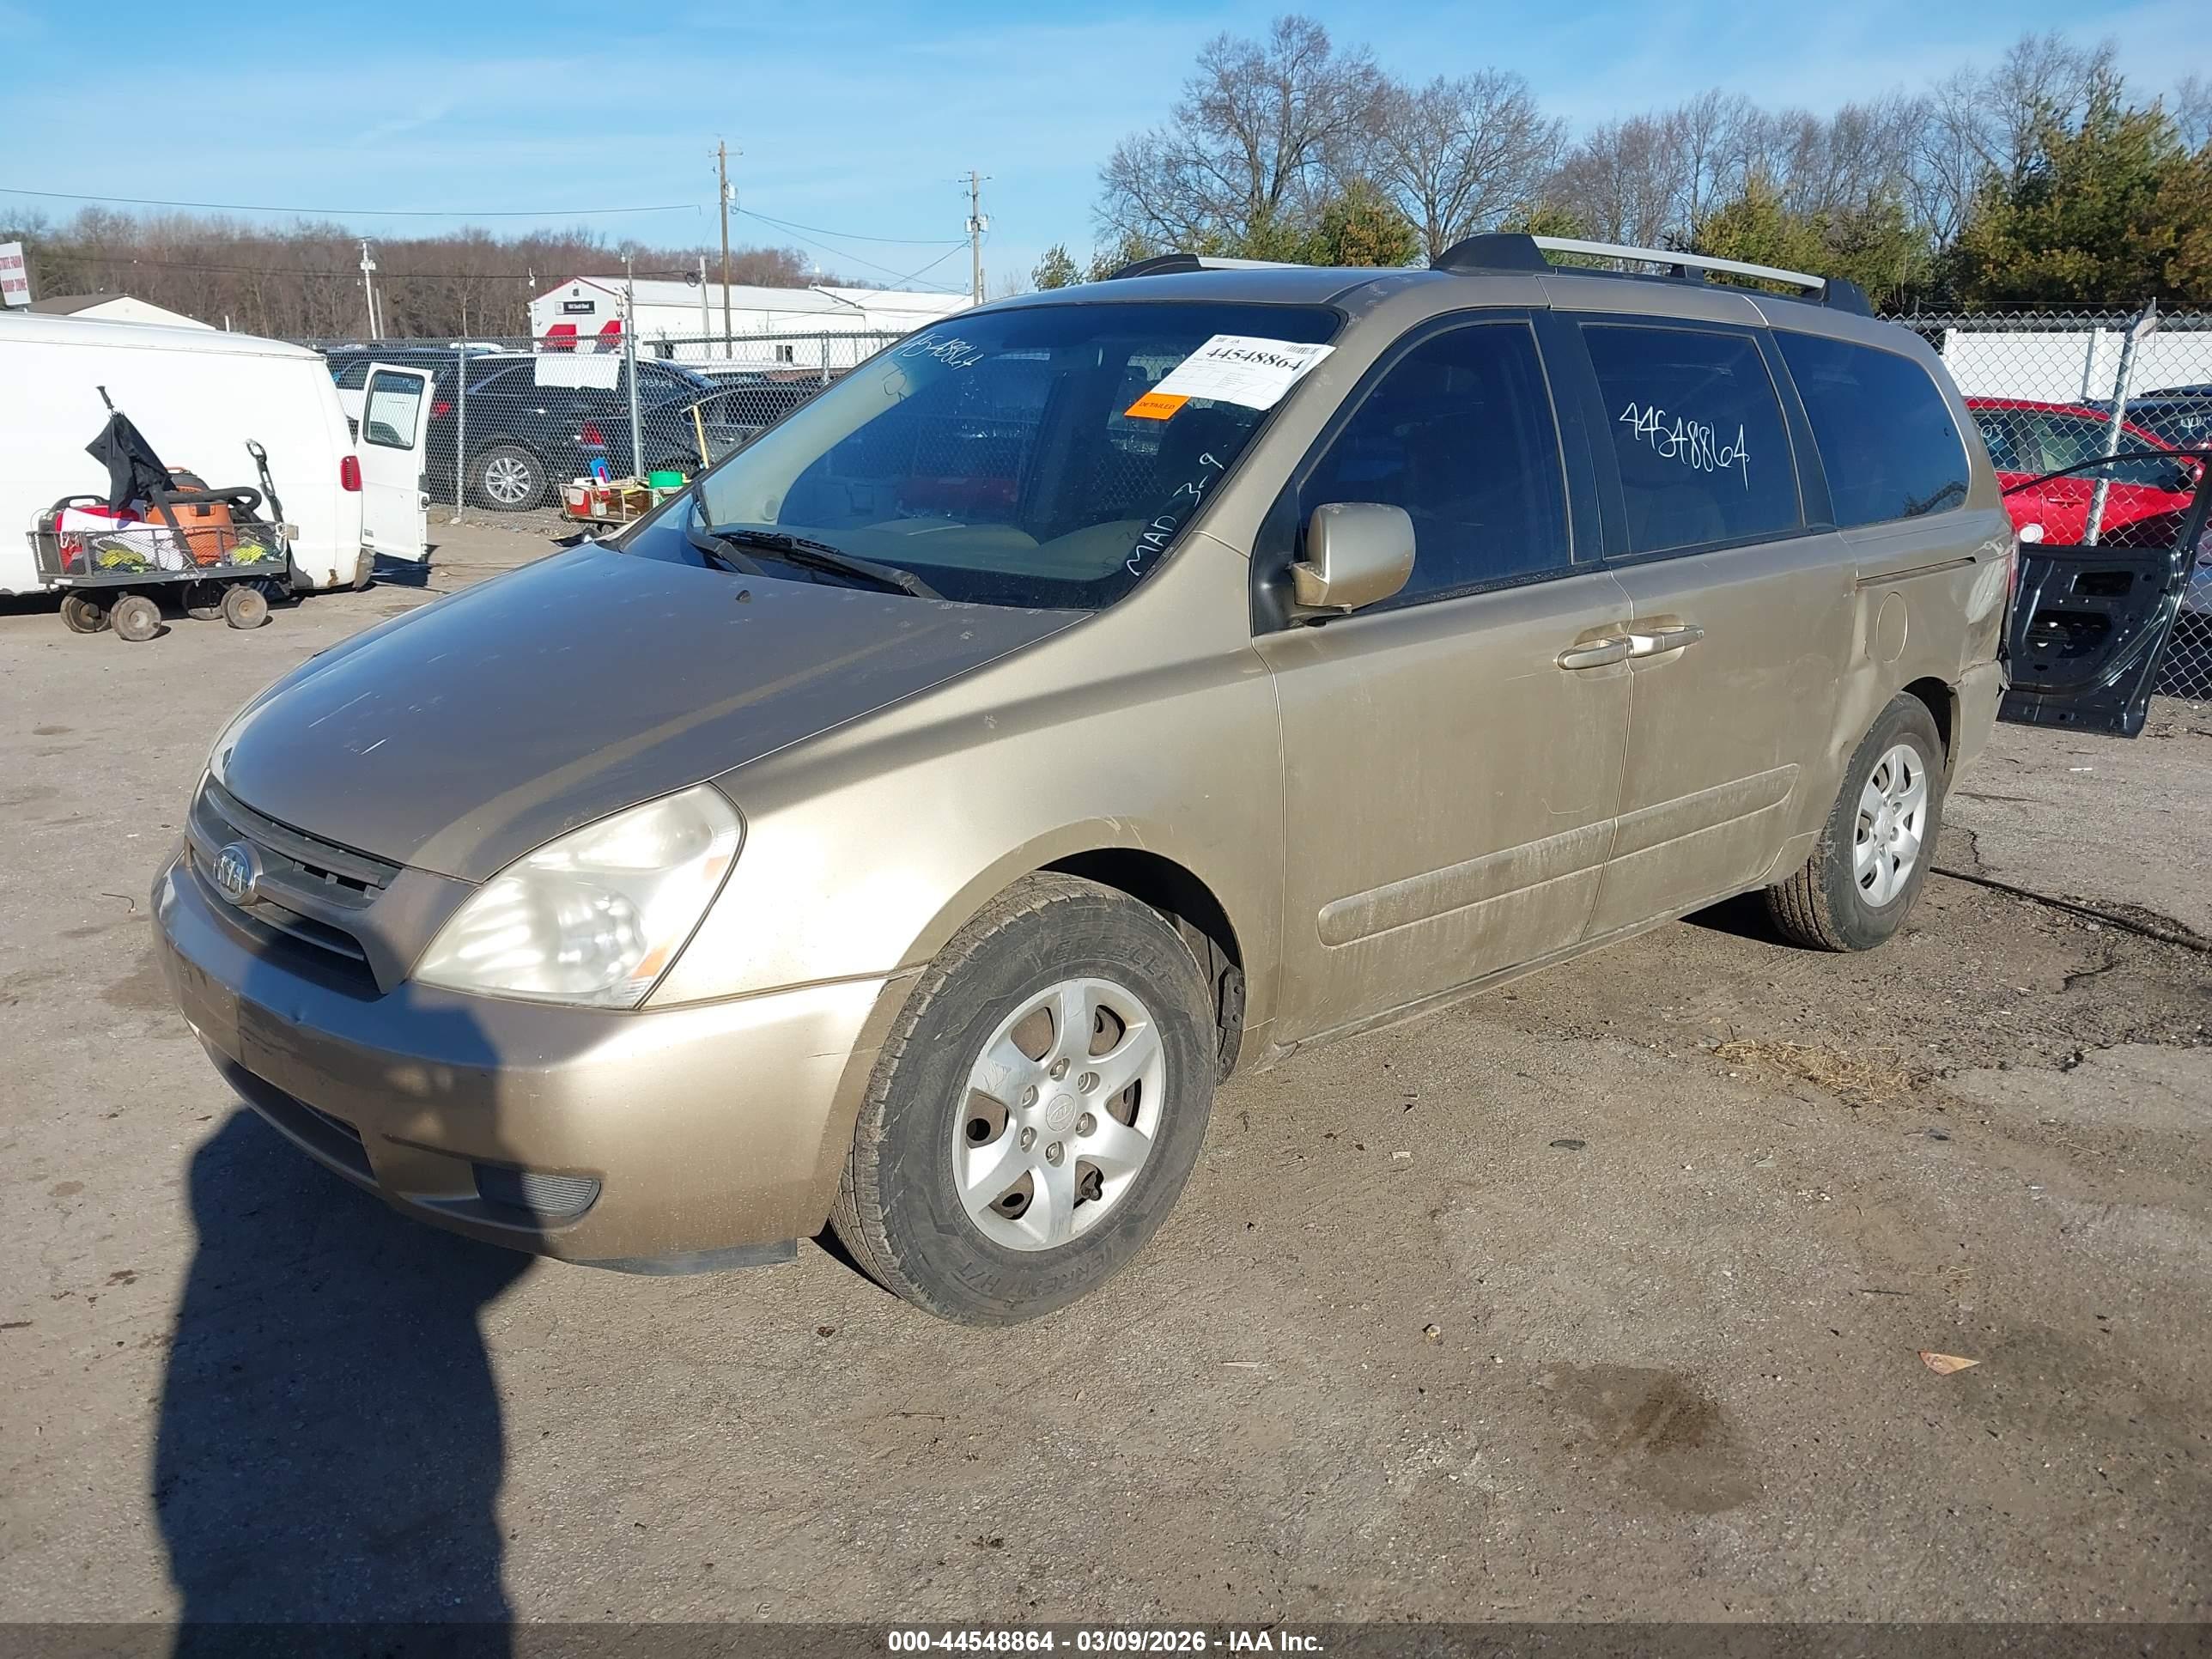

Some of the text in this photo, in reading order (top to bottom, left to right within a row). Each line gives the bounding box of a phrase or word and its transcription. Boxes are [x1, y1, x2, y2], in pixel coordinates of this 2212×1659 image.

[1206, 347, 1305, 372] 44548864
[1138, 400, 1176, 410] DETAILED
[1619, 402, 1751, 492] 44548864
[1125, 515, 1178, 576] MAD
